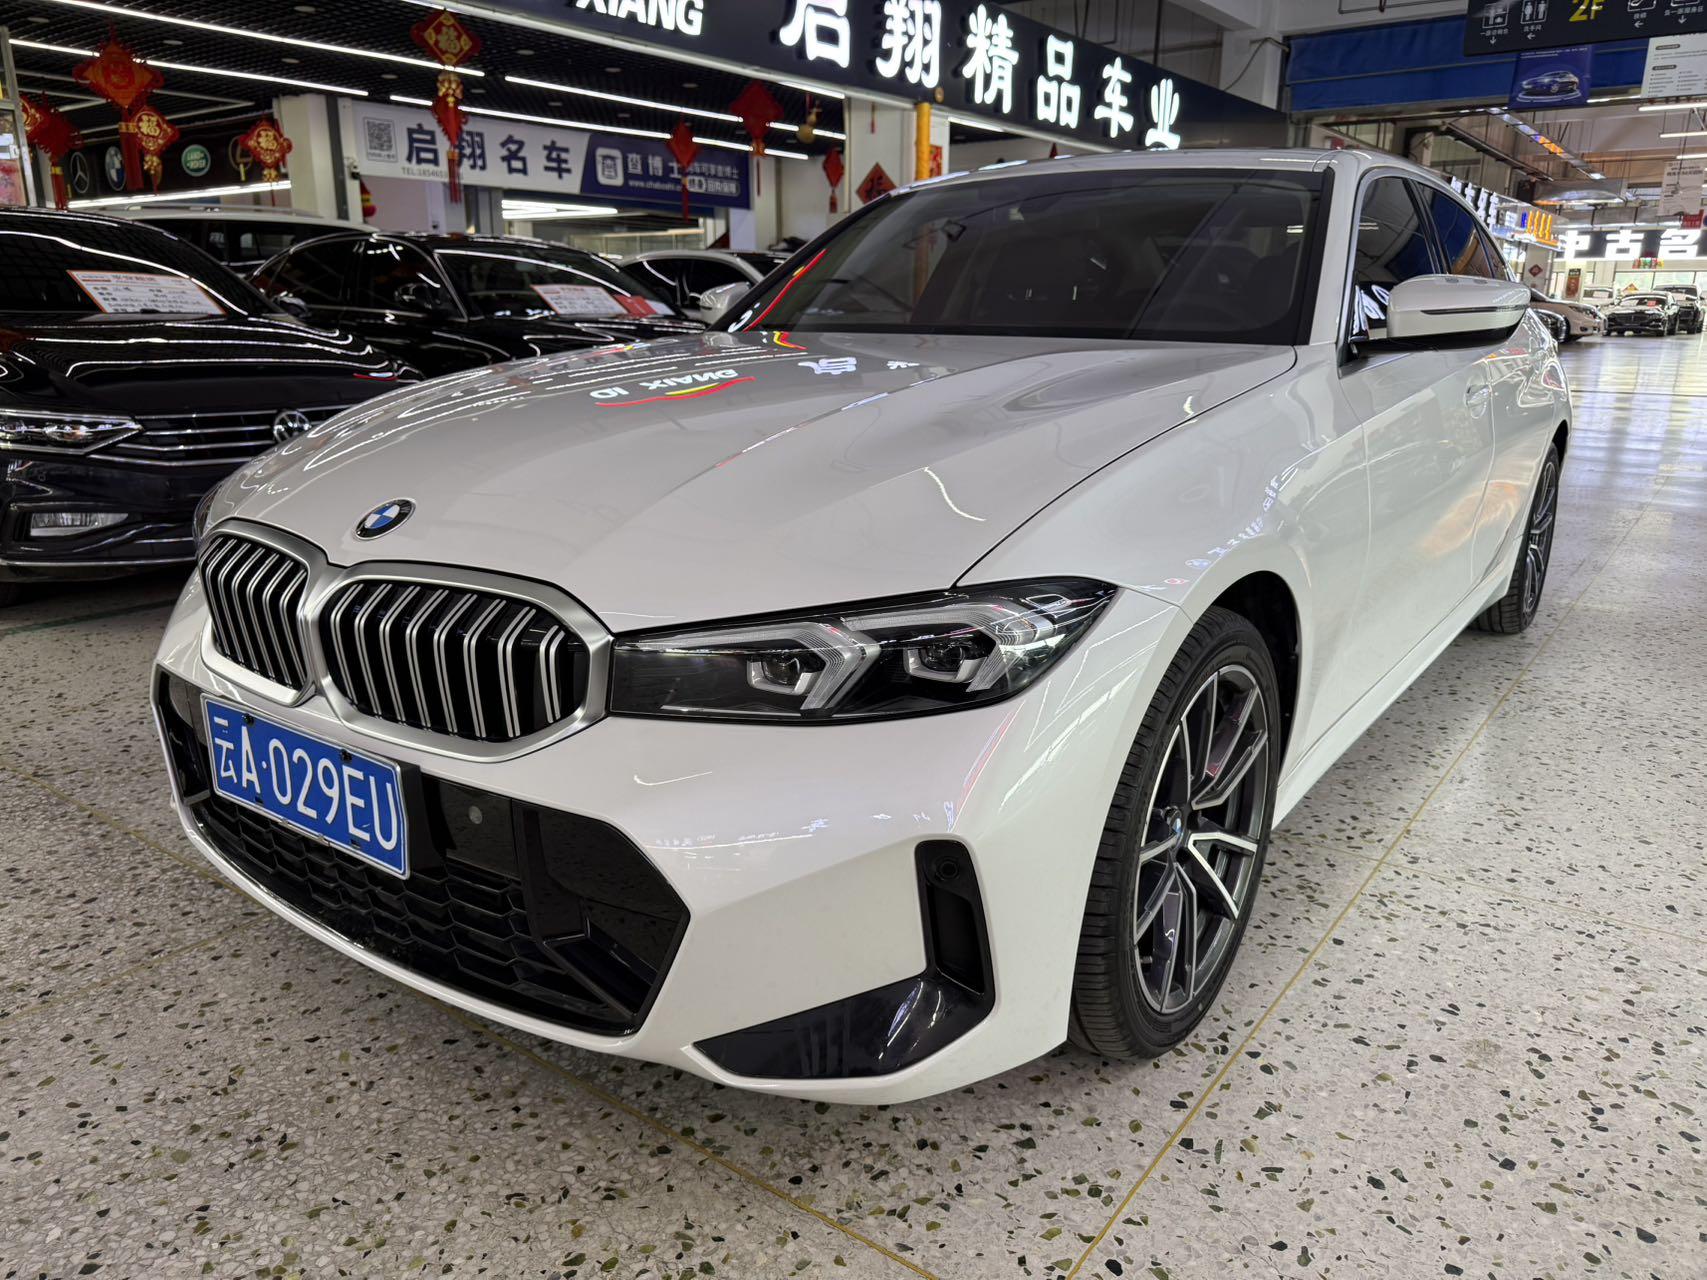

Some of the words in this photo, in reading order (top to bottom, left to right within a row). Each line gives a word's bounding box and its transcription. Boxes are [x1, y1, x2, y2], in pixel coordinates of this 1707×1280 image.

[576, 0, 703, 36] ANG
[779, 0, 1181, 150] 启翔精品车业
[406, 123, 573, 180] 启翔名车
